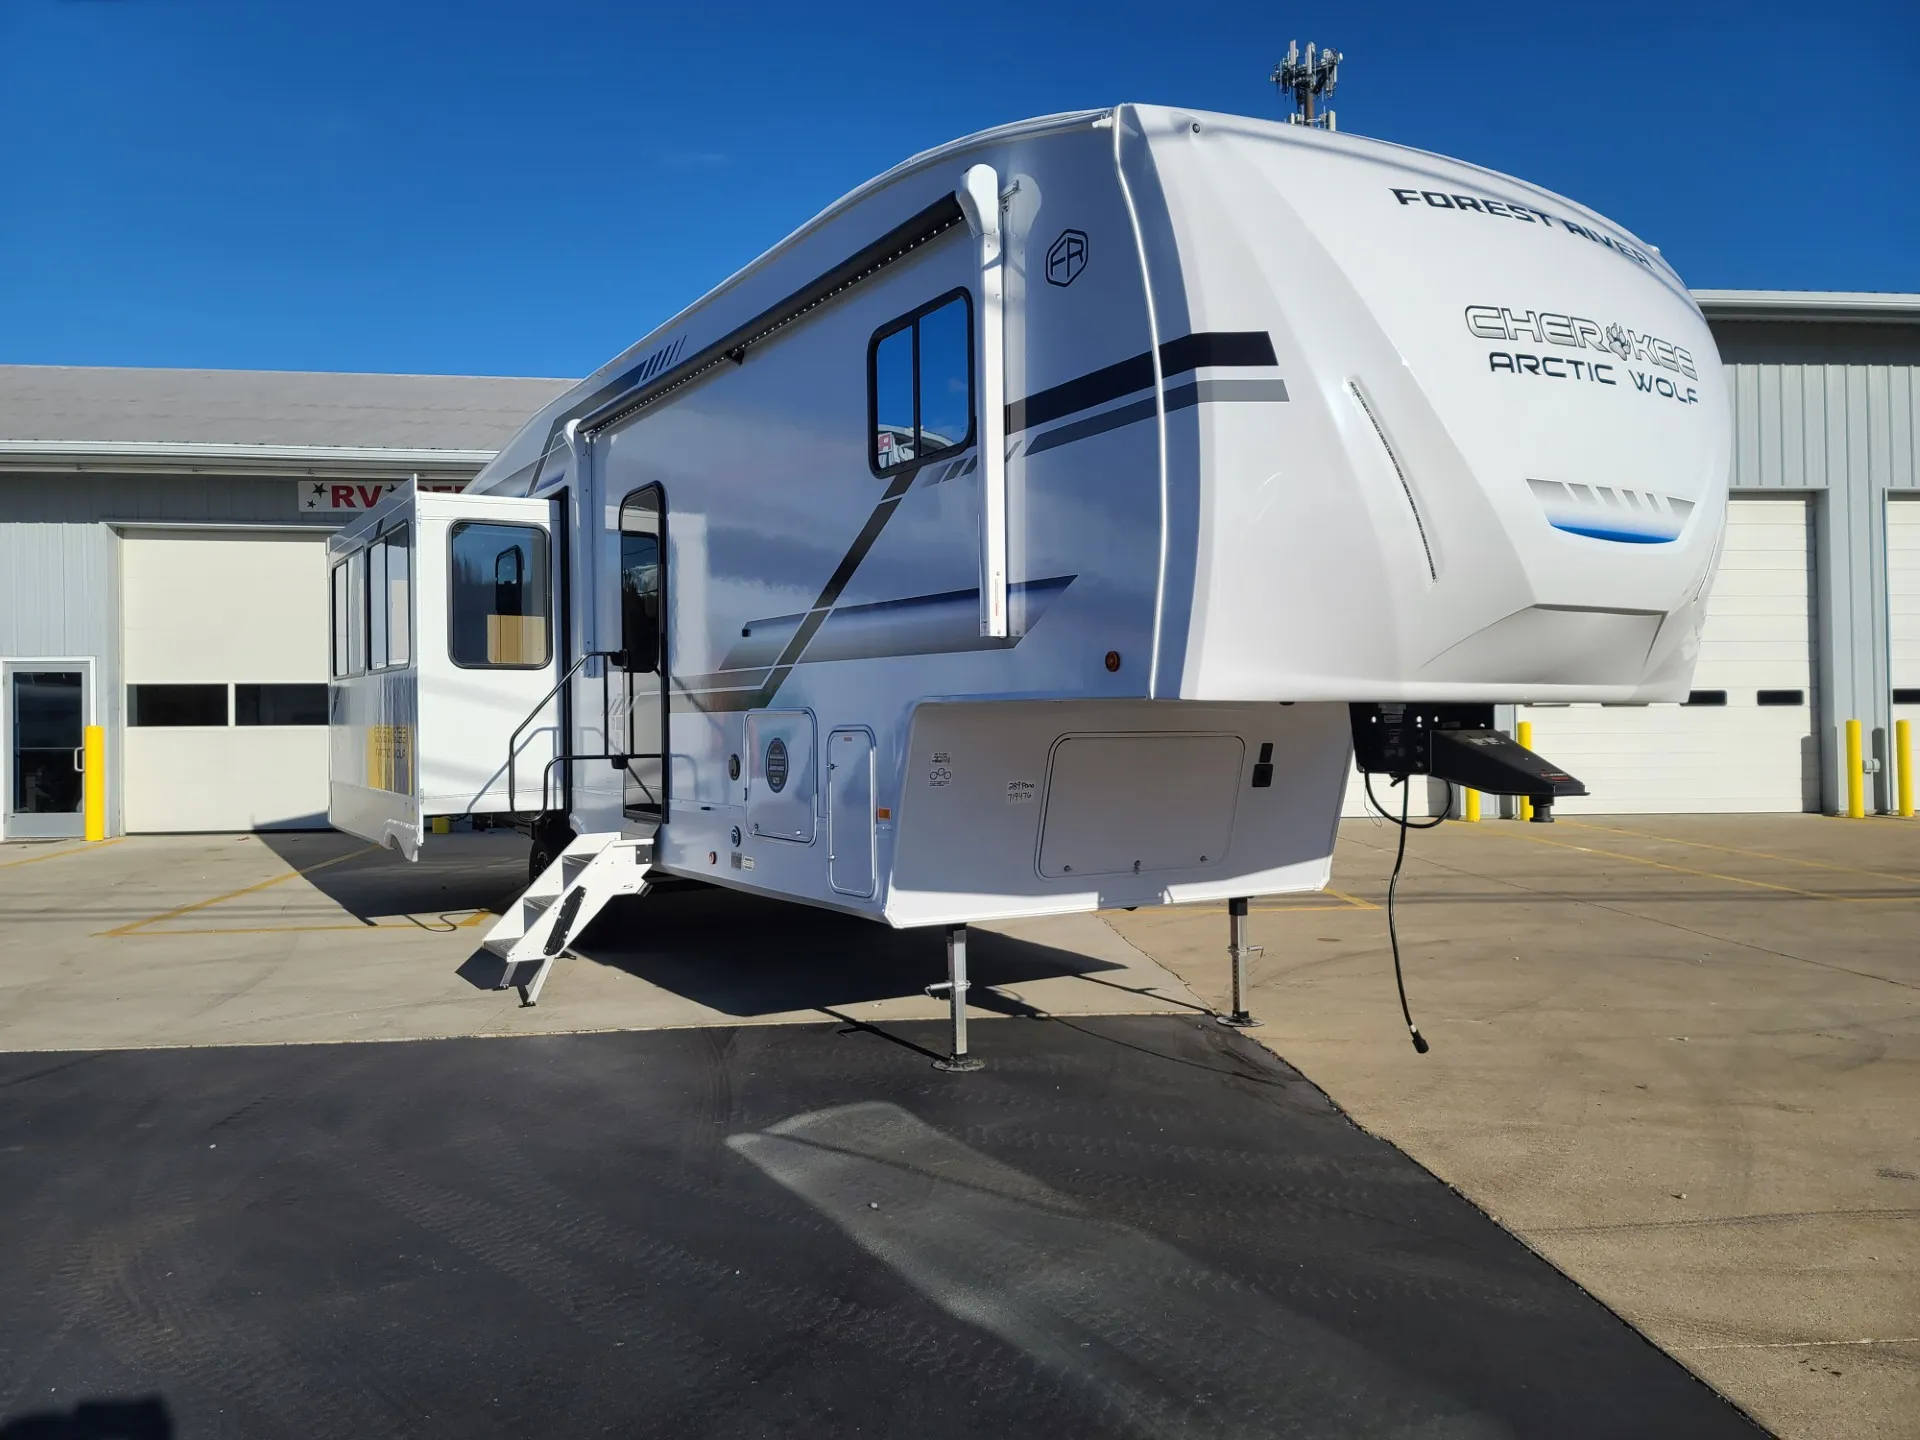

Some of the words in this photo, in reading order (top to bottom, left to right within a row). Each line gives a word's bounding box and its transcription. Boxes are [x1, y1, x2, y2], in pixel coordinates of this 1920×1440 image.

[1388, 188, 1552, 227] FOREST
[1561, 218, 1656, 270] RIVER
[1489, 351, 1616, 385] ARCTIC
[1628, 369, 1699, 404] WOLF
[331, 485, 383, 508] RV
